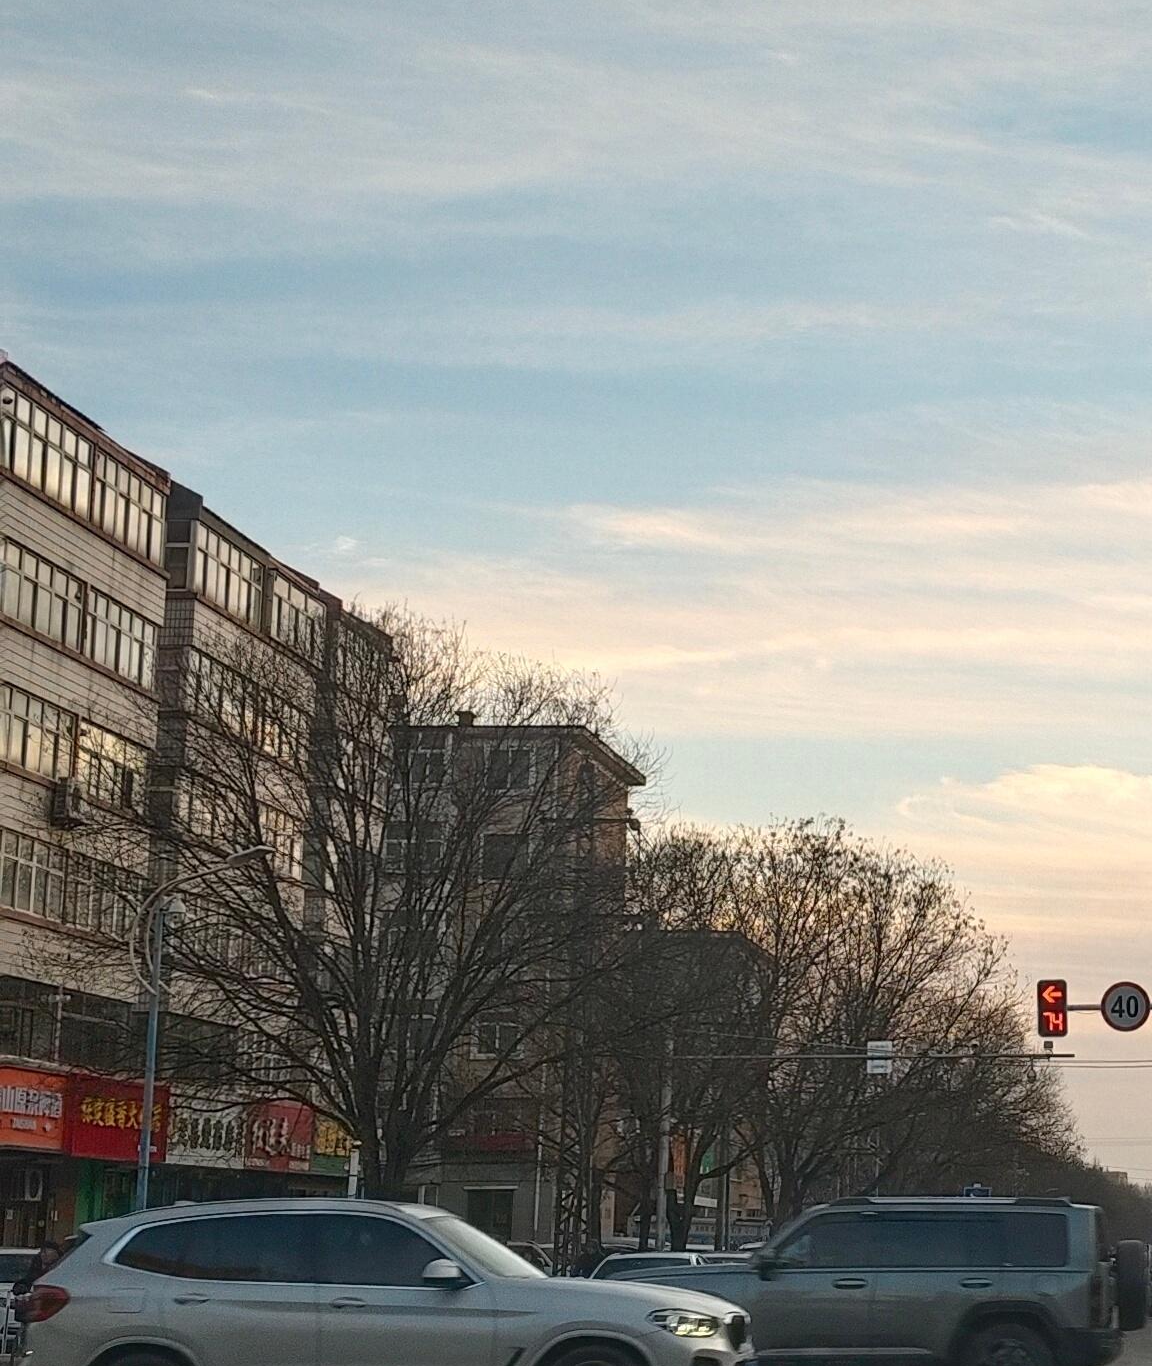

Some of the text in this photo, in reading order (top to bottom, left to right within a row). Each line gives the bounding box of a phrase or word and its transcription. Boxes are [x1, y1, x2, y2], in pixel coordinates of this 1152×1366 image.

[1111, 995, 1139, 1018] 40
[1043, 1011, 1064, 1031] 74
[0, 1085, 63, 1119] 山原浆啤酒
